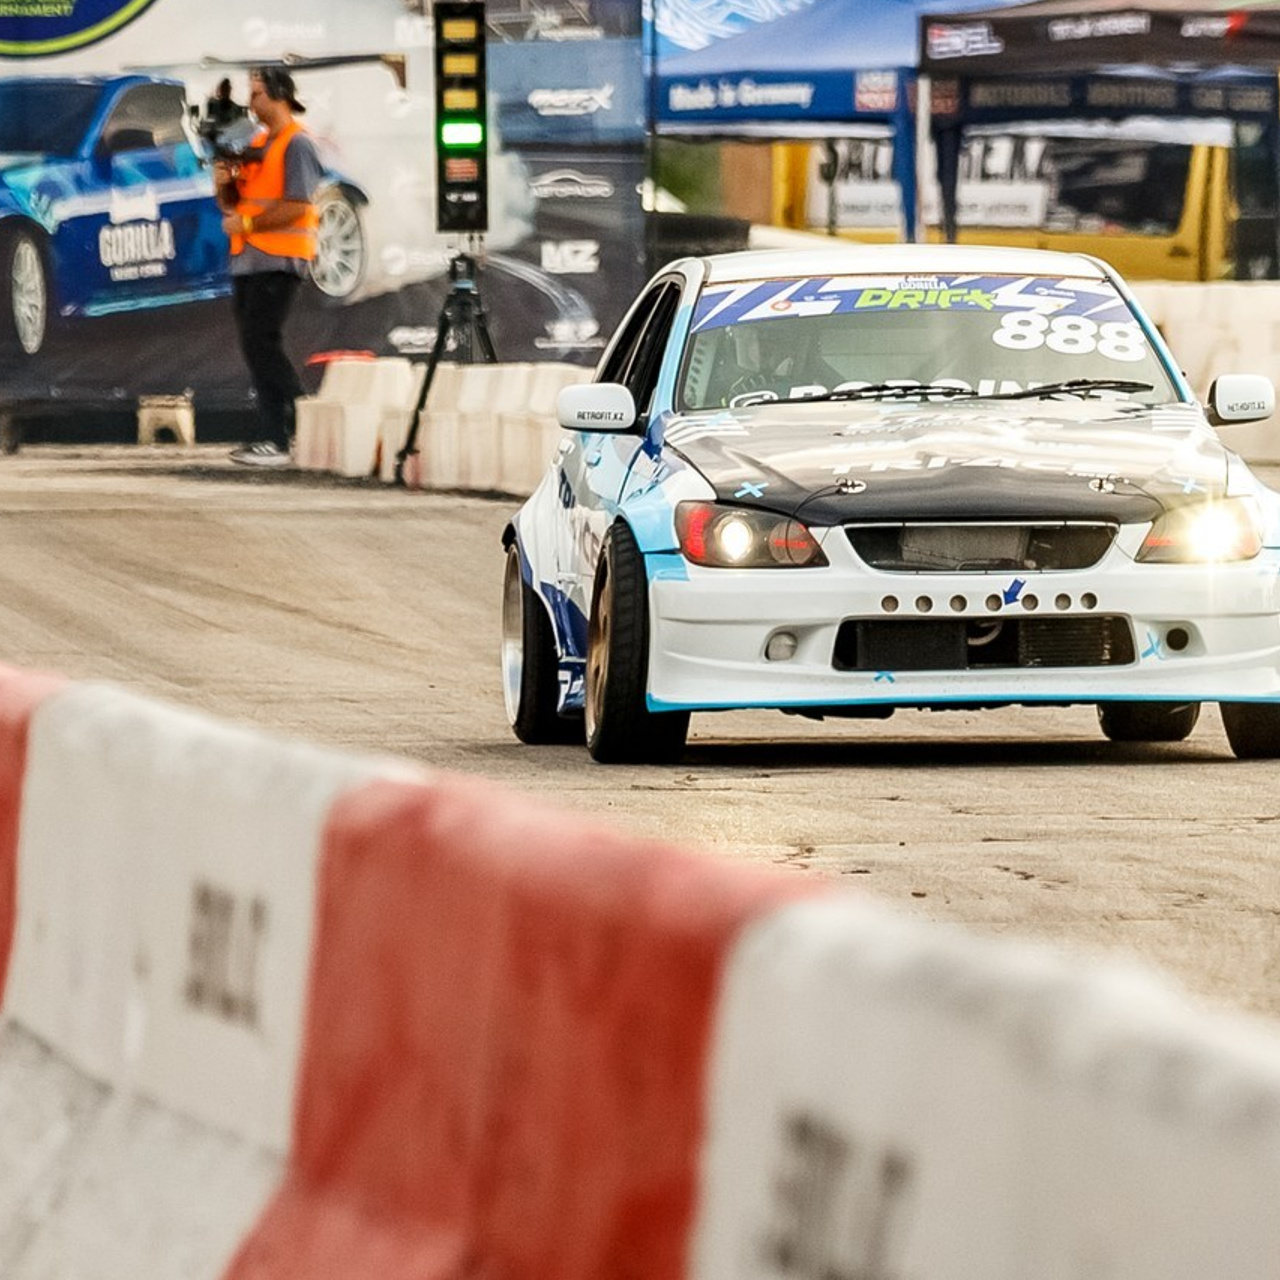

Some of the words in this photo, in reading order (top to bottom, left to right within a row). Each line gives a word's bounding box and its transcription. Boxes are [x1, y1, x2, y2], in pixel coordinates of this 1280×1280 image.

[99, 219, 176, 268] GORILLA
[992, 311, 1147, 362] 888
[577, 411, 625, 421] RETROFIT.KZ
